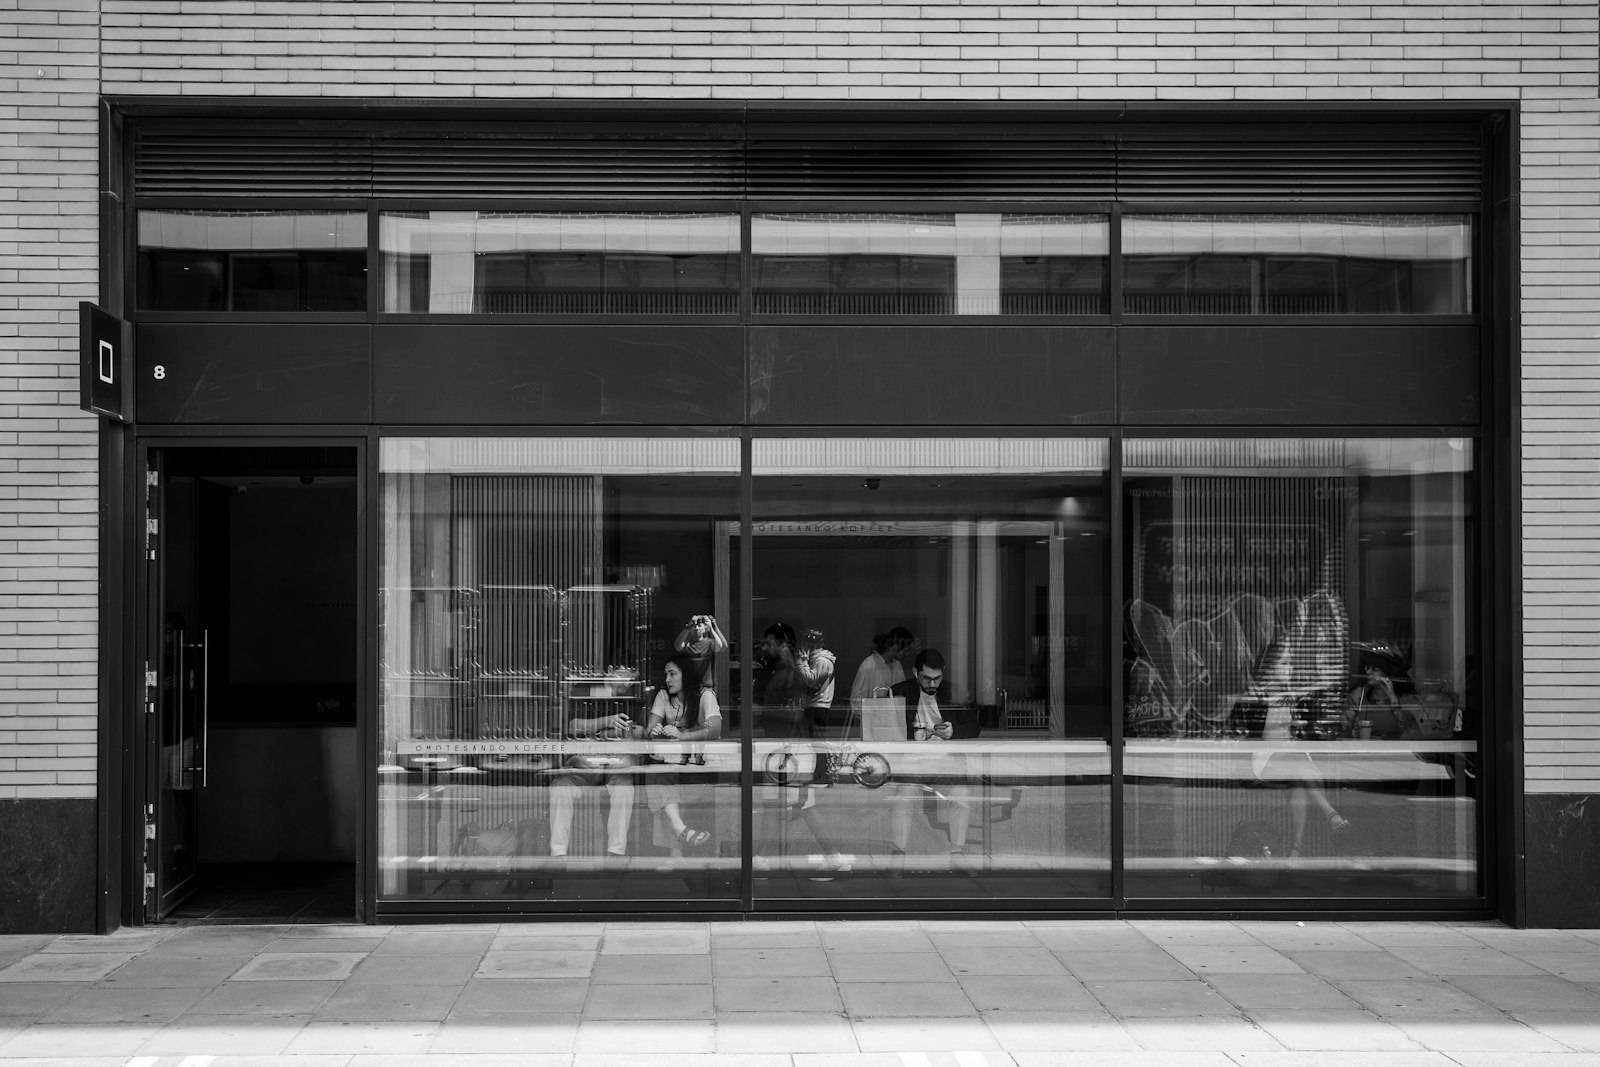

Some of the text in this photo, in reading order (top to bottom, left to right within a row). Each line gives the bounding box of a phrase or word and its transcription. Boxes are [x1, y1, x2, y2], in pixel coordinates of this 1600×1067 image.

[153, 365, 165, 380] 8
[752, 524, 834, 532] OTESANDO
[415, 744, 565, 752] OMOTESANDO KOFFEE
